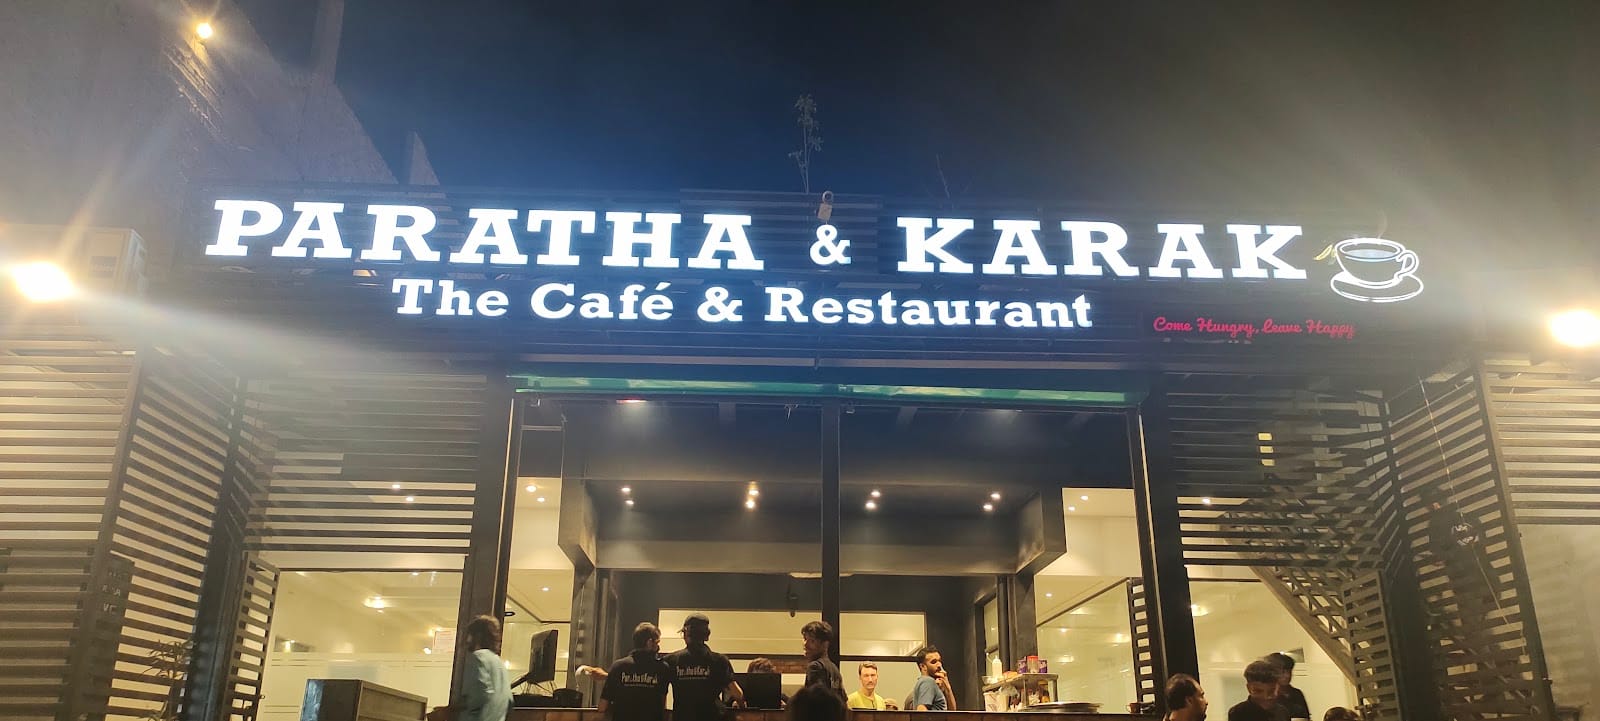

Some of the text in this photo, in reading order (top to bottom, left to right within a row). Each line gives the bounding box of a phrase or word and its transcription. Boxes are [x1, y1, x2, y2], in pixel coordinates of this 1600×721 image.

[205, 199, 1308, 280] PARATHA & KARAK
[392, 278, 1093, 328] The Café & Restaurant
[1153, 316, 1355, 339] Come Hungry, Leave Happy
